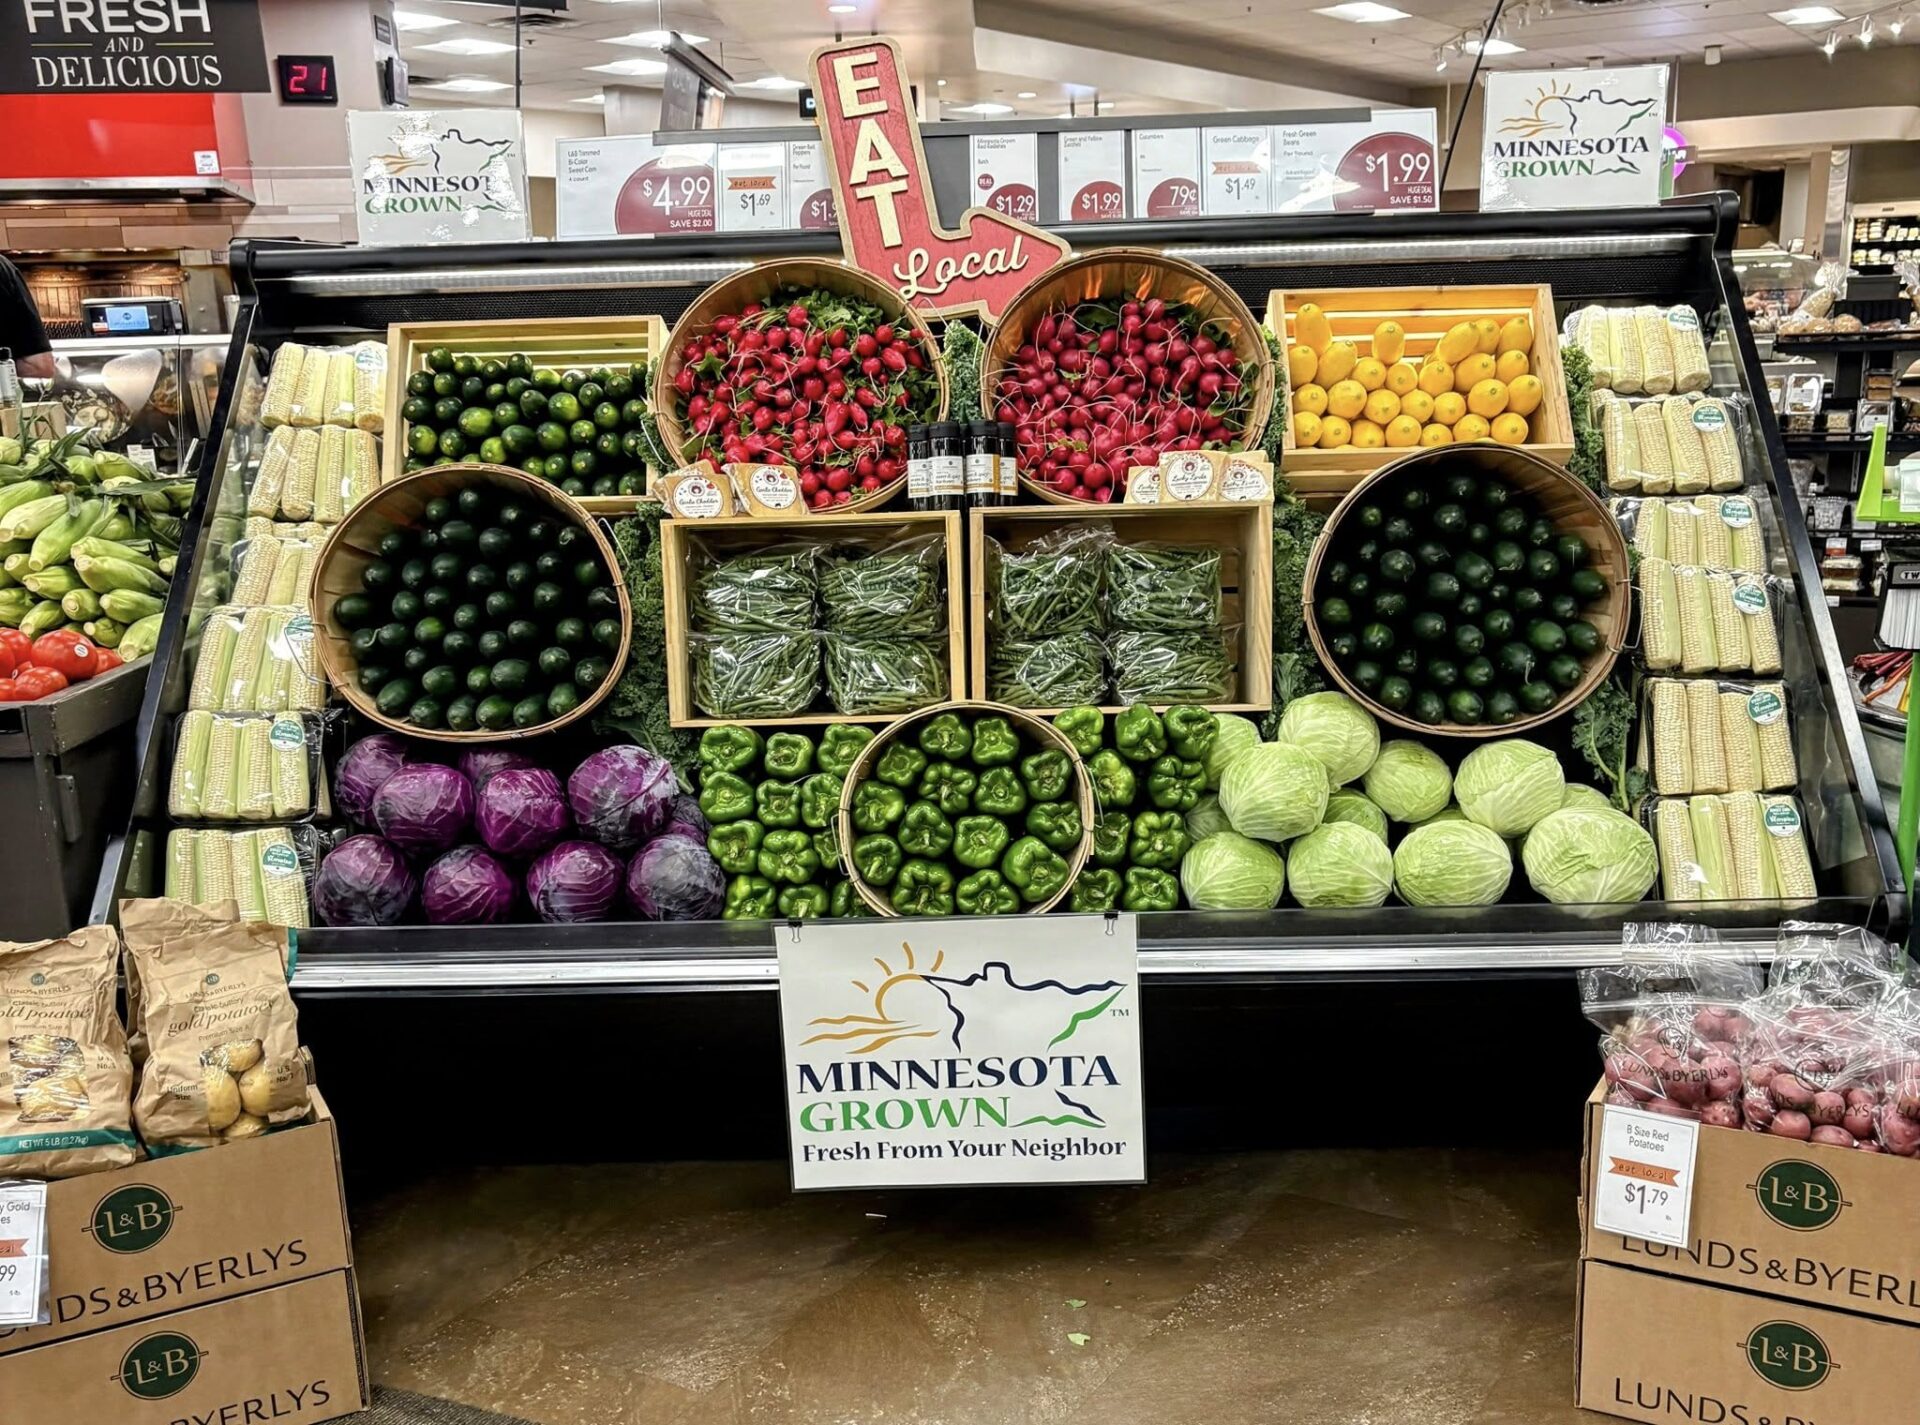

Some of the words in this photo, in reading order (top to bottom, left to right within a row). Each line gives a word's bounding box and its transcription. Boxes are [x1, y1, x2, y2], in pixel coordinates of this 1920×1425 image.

[24, 0, 211, 33] FRESH
[104, 36, 144, 53] AND
[31, 55, 222, 87] DELICIOUS
[289, 65, 327, 94] 21
[1213, 136, 1232, 144] Green
[1233, 135, 1260, 144] Cabbage
[1283, 130, 1298, 138] Fresh
[832, 51, 910, 248] EAT
[1493, 136, 1650, 158] MINNESOTA
[1366, 152, 1430, 192] $1.99
[1498, 159, 1595, 178] GROWN
[643, 176, 711, 216] $4.99
[1170, 185, 1197, 206] 79¢
[1225, 178, 1256, 200] $1.49
[1390, 195, 1412, 205] SAVE
[740, 193, 771, 216] $1.69
[996, 194, 1034, 217] $1.29
[1082, 192, 1121, 214] $1.99
[670, 219, 691, 228] SAVE
[692, 218, 713, 227] $2.00
[893, 235, 1029, 301] Local
[1110, 1008, 1130, 1017] TM
[168, 1012, 205, 1037] gold
[796, 1055, 1122, 1094] MINNESOTA
[167, 1083, 198, 1094] Uniform
[800, 1096, 1011, 1133] GROWN
[1627, 1124, 1632, 1134] B
[1634, 1126, 1651, 1138] Size
[1652, 1129, 1669, 1141] Red
[1628, 1136, 1665, 1152] Potatoes
[803, 1142, 871, 1163] Fresh
[877, 1140, 943, 1160] From
[947, 1139, 1007, 1159] Your
[1011, 1137, 1126, 1161] Neighbor
[1618, 1162, 1636, 1175] eat
[1642, 1168, 1668, 1181] local
[1624, 1182, 1669, 1214] $1.79
[1770, 1176, 1829, 1213] L&B
[7, 1201, 30, 1212] Gold
[104, 1202, 163, 1237] L&B
[132, 1348, 190, 1385] L&B
[1759, 1337, 1818, 1373] L&B
